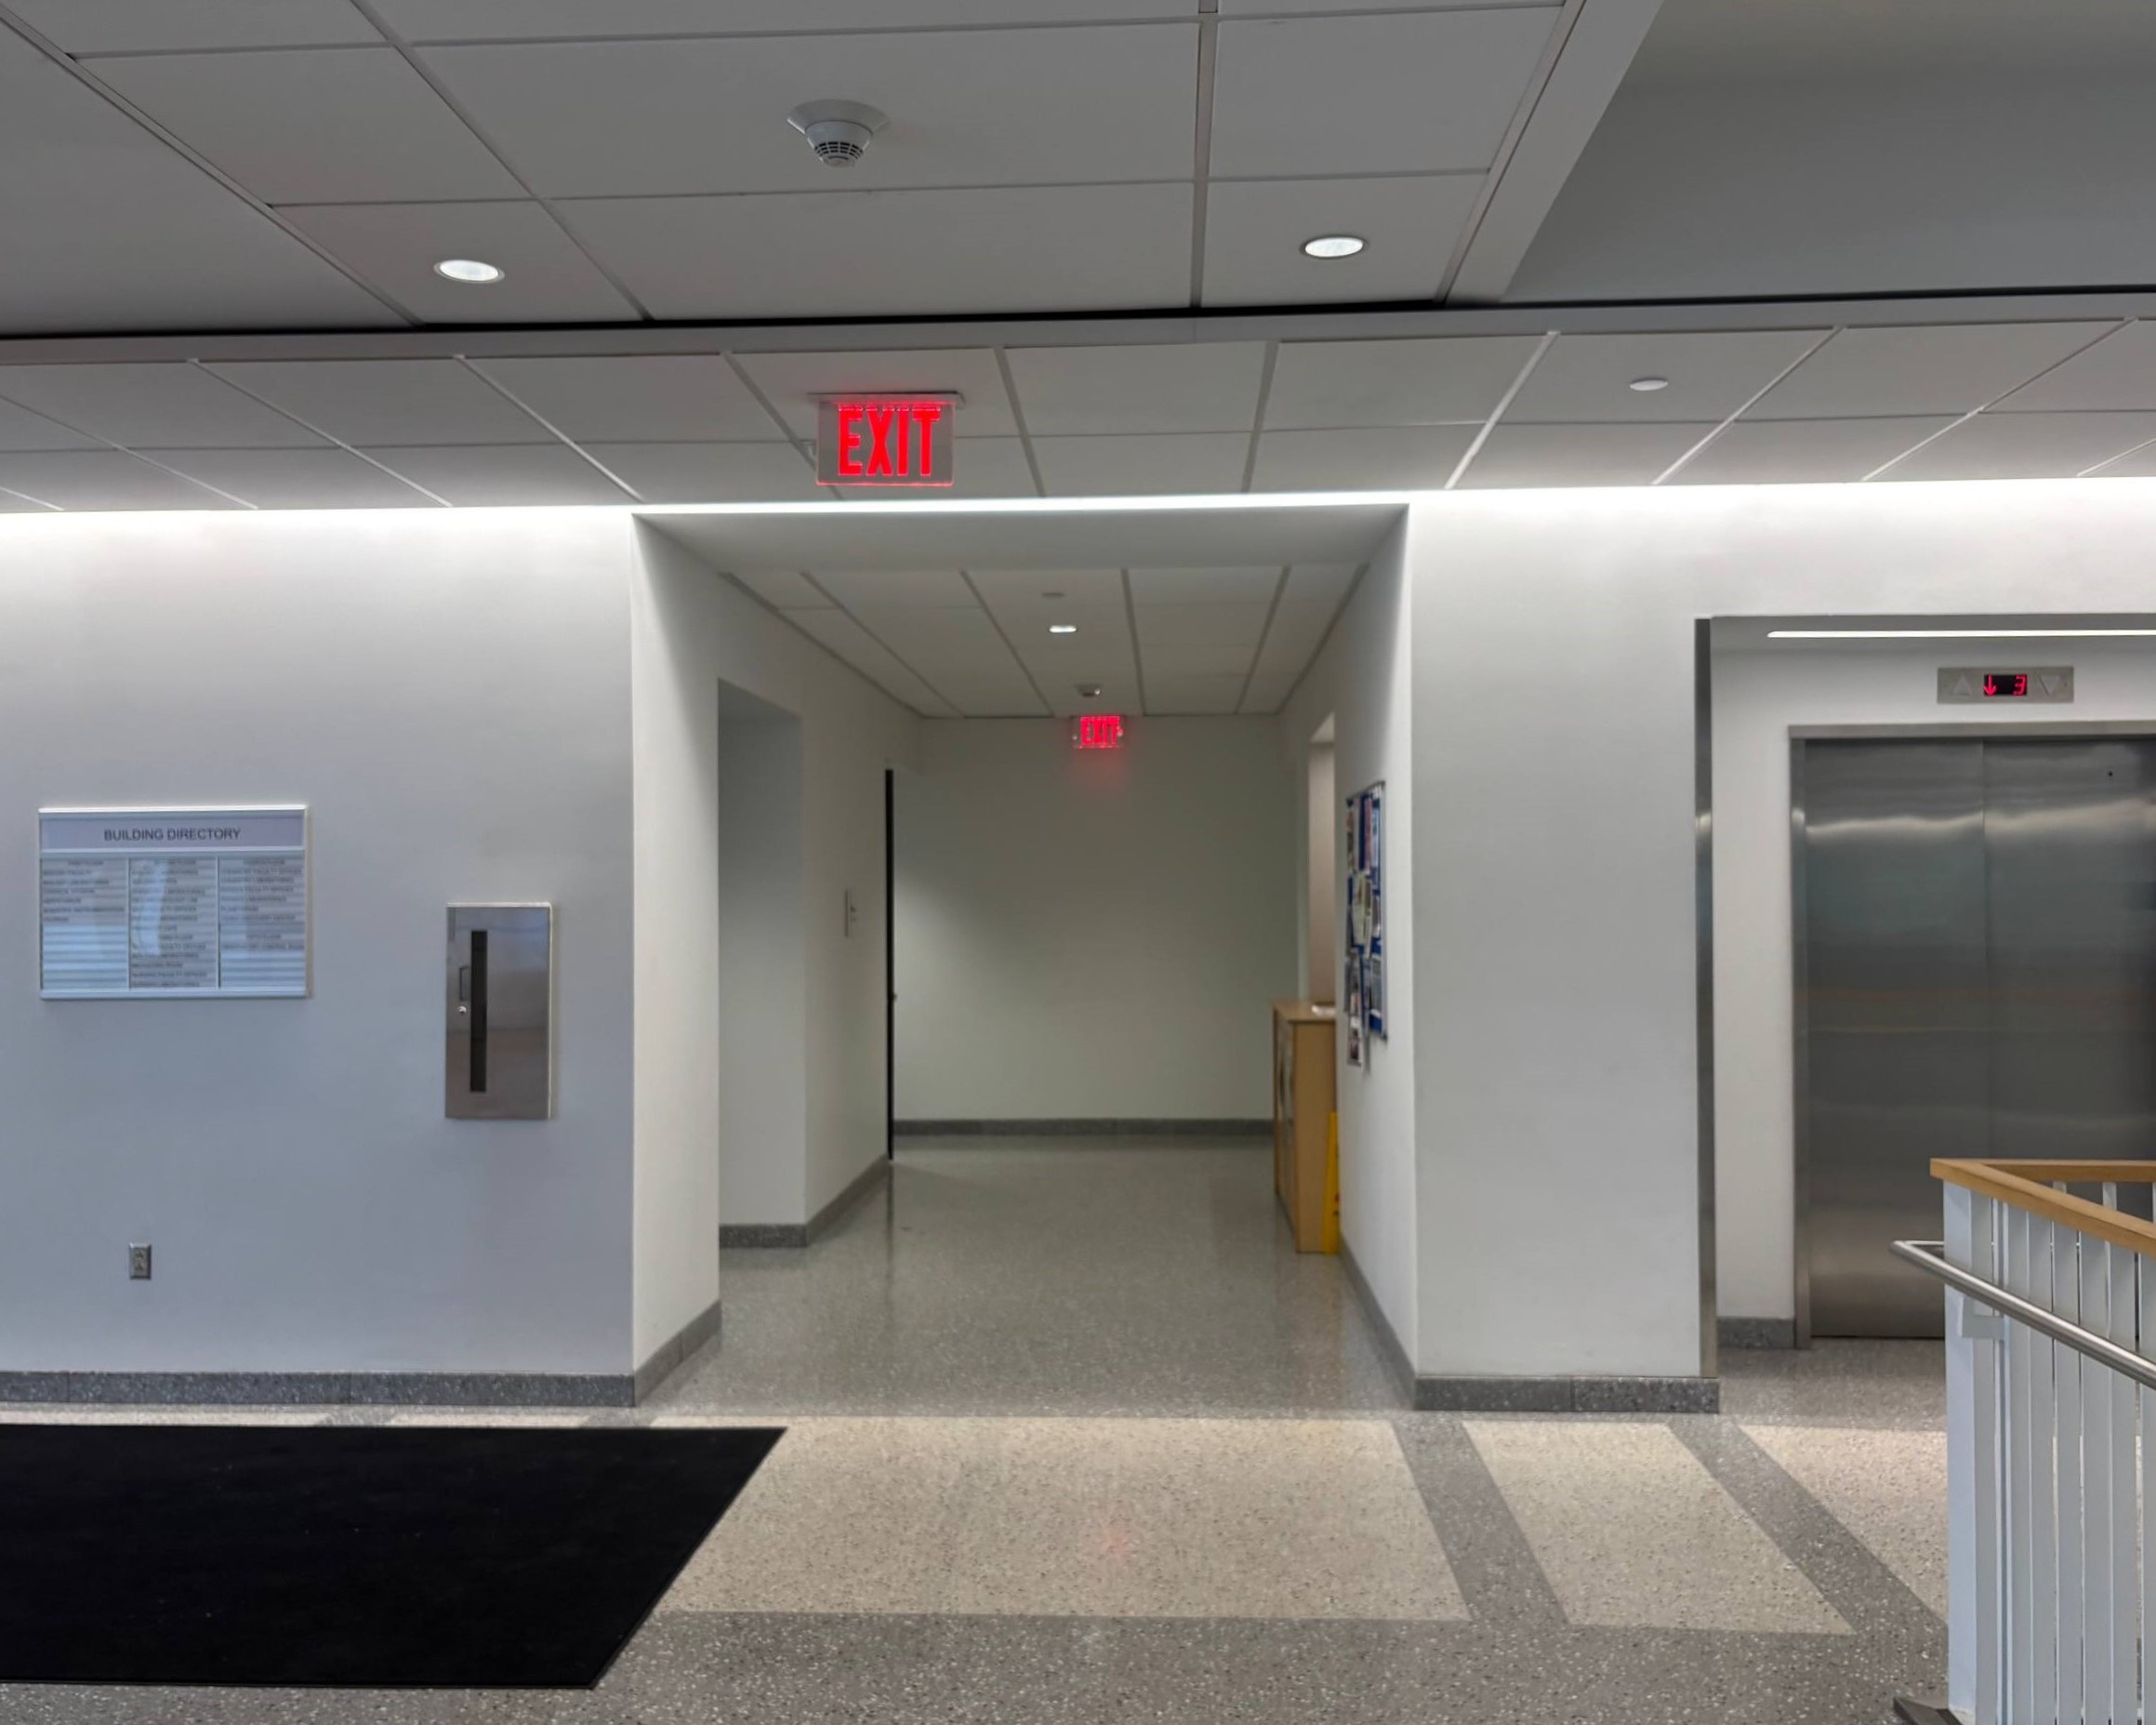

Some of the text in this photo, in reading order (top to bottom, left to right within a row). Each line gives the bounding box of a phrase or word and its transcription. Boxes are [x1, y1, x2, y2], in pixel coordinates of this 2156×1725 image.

[838, 405, 941, 477] EXIT
[2013, 675, 2028, 696] 3
[1080, 716, 1120, 745] EXIT
[104, 827, 241, 842] BUILDING DIRECTORY
